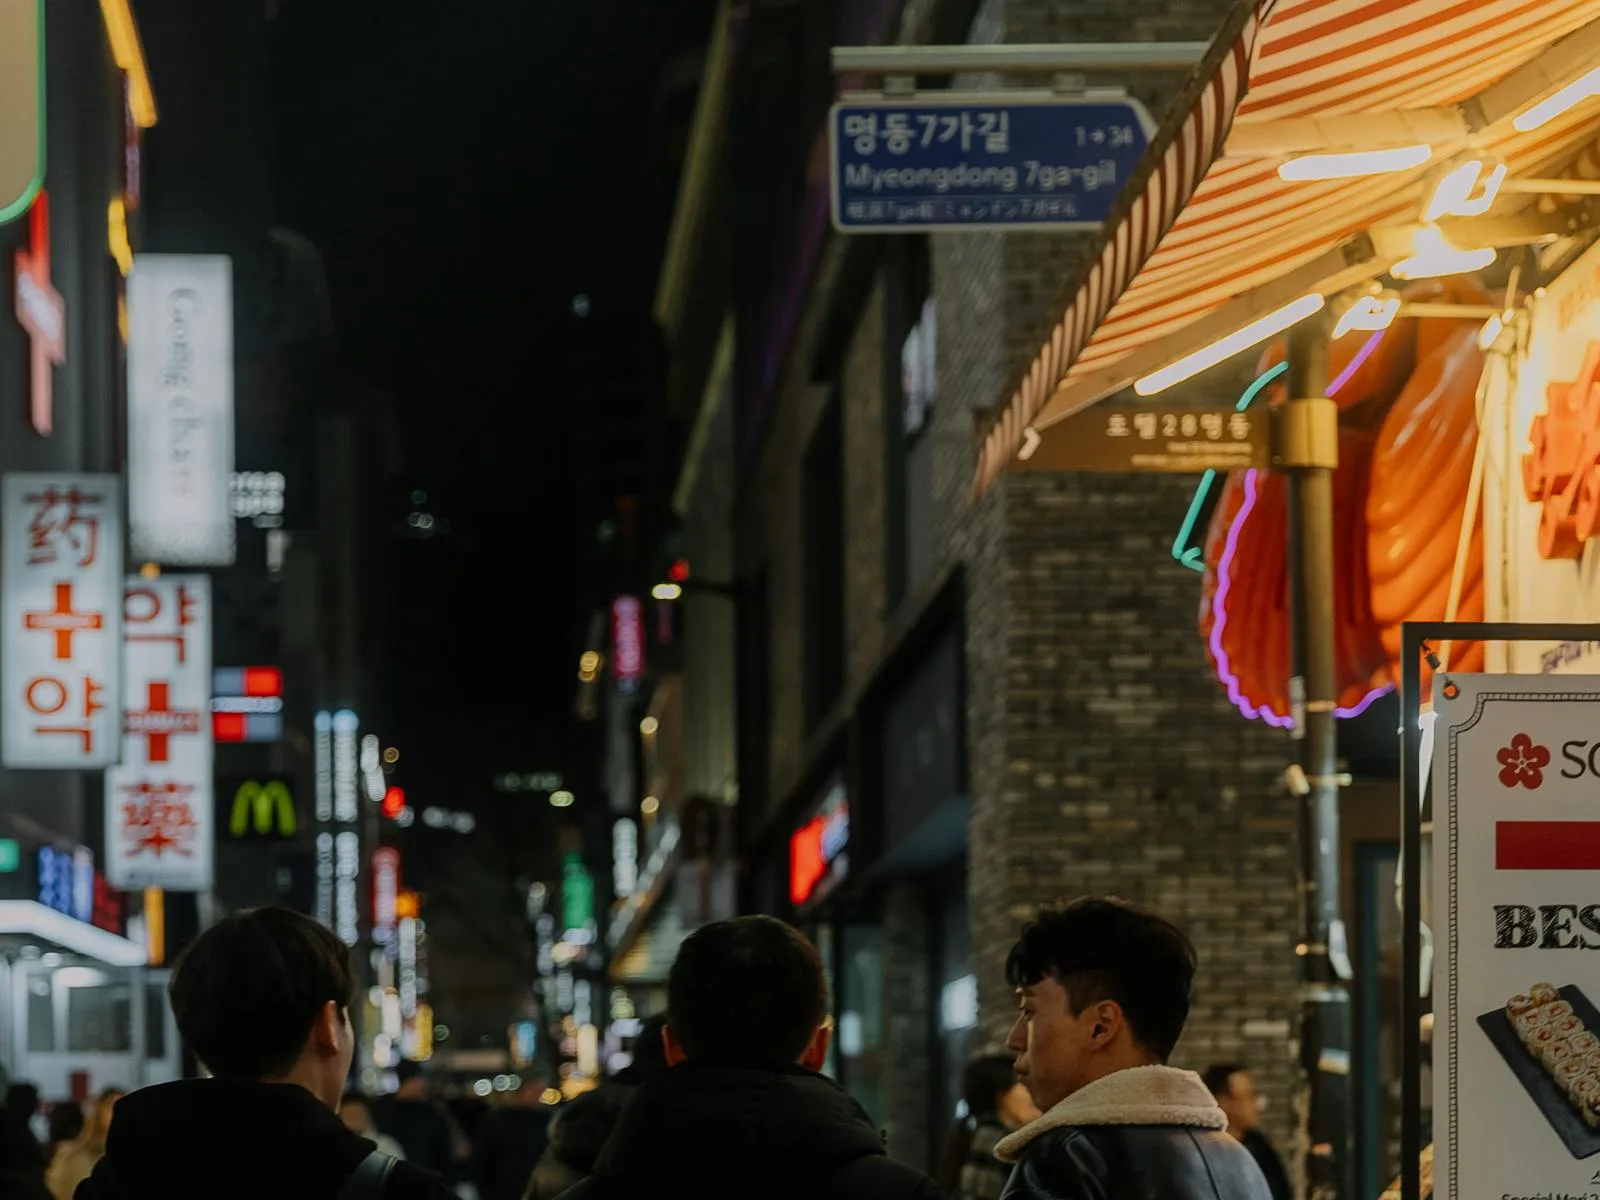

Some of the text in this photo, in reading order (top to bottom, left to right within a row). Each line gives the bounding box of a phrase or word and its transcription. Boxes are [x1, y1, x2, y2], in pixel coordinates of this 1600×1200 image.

[844, 111, 1010, 156] 명동7가길
[1075, 125, 1134, 147] 1 34
[845, 158, 1116, 194] Myeongdong 7ga-gil
[22, 486, 103, 567] 药
[123, 585, 196, 664] 약
[26, 675, 105, 755] 약
